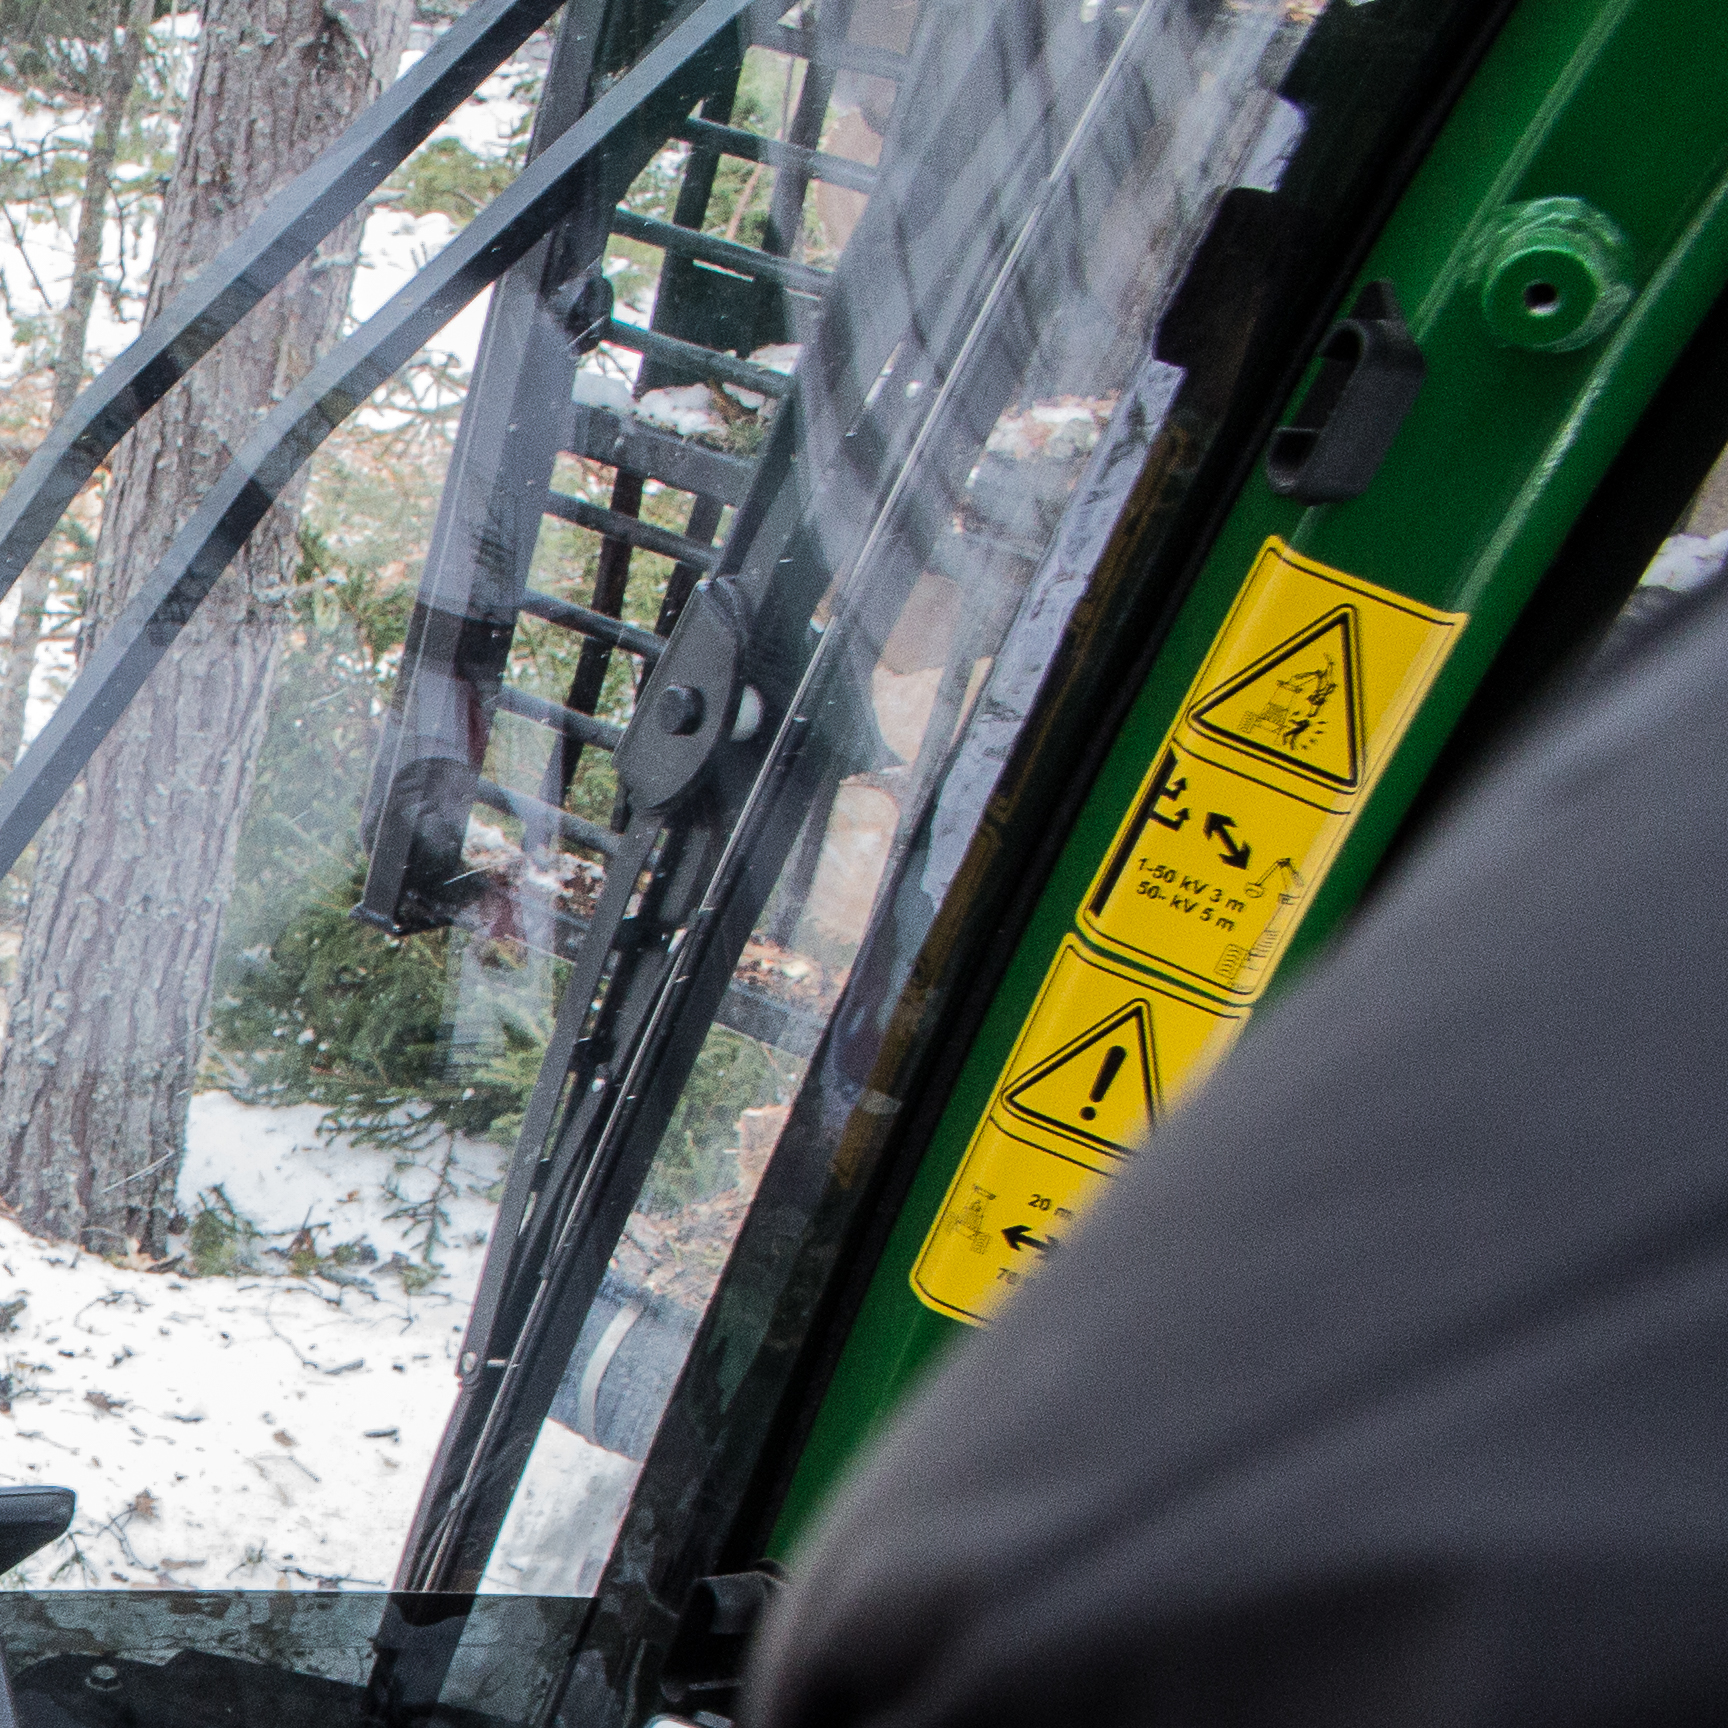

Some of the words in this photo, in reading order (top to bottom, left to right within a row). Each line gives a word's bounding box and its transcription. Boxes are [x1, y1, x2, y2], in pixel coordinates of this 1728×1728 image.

[1139, 857, 1177, 884] 1-50
[1179, 875, 1210, 895] kV
[1209, 888, 1223, 903] 3
[1225, 898, 1246, 913] m
[1169, 894, 1199, 913] kV
[1199, 907, 1215, 922] 5
[1215, 917, 1236, 932] m
[1027, 1193, 1052, 1211] 20
